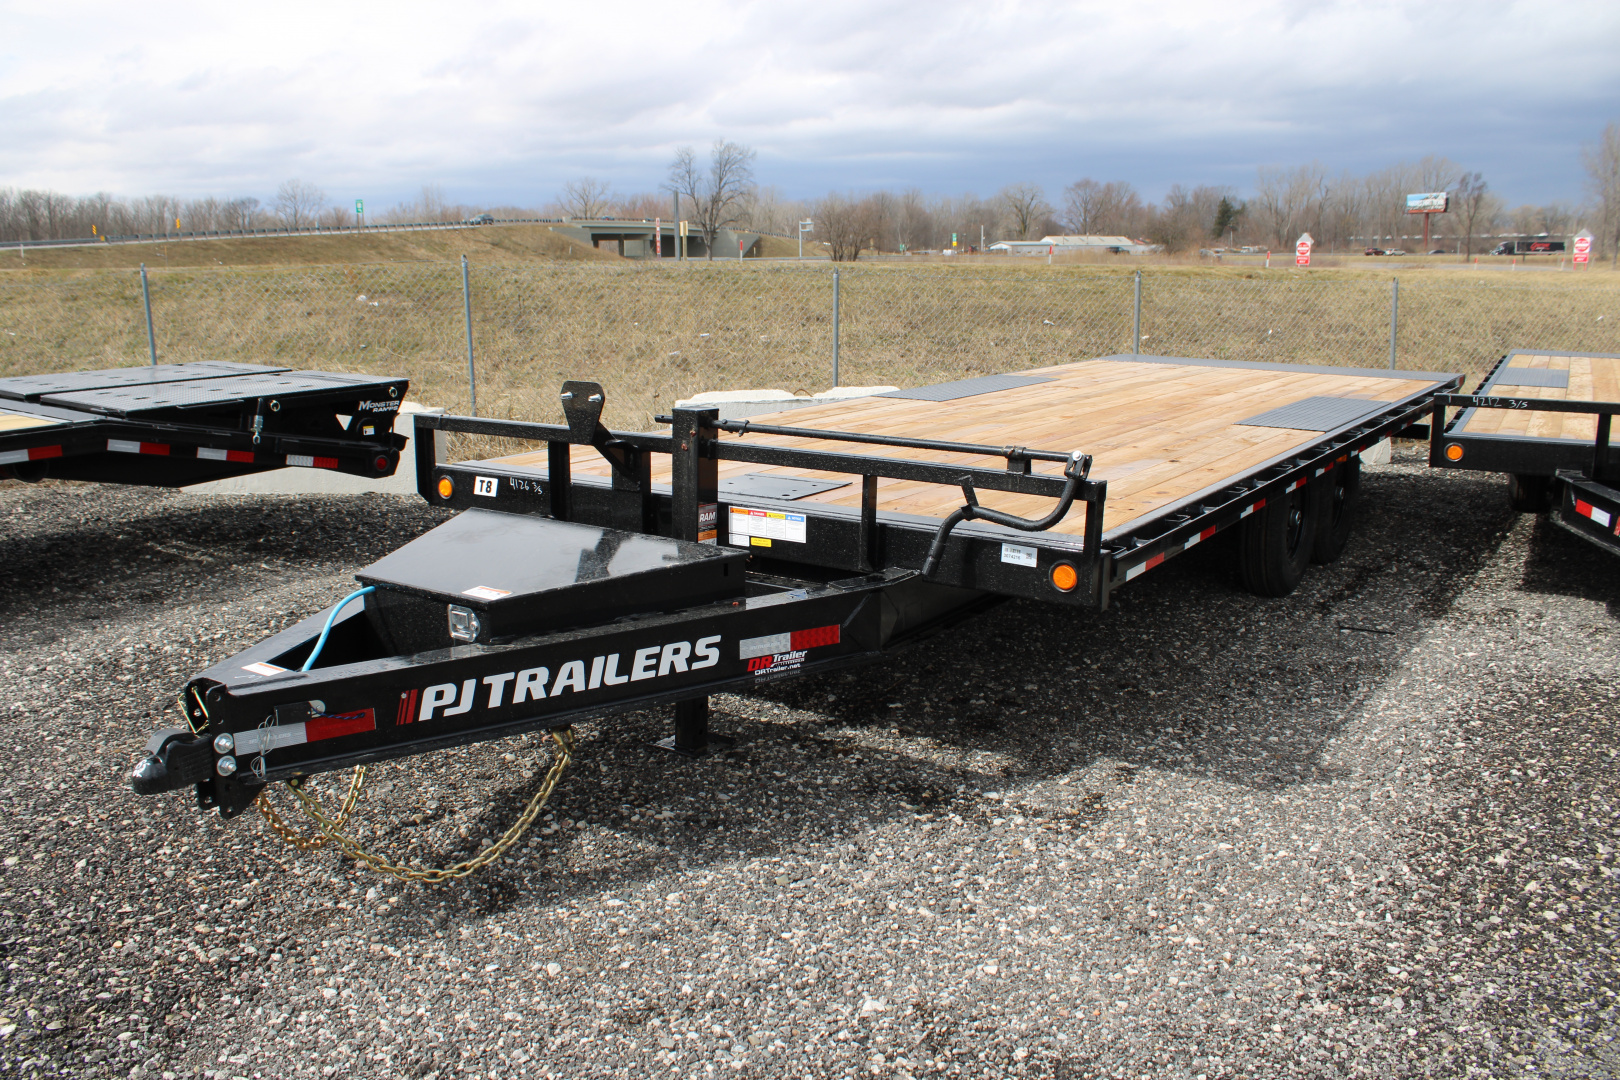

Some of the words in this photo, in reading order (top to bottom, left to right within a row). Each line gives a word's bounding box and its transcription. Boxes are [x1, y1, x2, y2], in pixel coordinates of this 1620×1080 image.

[358, 400, 400, 411] MONSTER
[479, 479, 493, 494] T8
[509, 476, 530, 491] 4126
[699, 511, 716, 523] RAM
[747, 655, 773, 672] DR
[772, 650, 808, 663] Trailer
[754, 663, 801, 676] DRTrailer.net
[418, 679, 477, 721] PJ
[483, 635, 722, 709] TRAILERS
